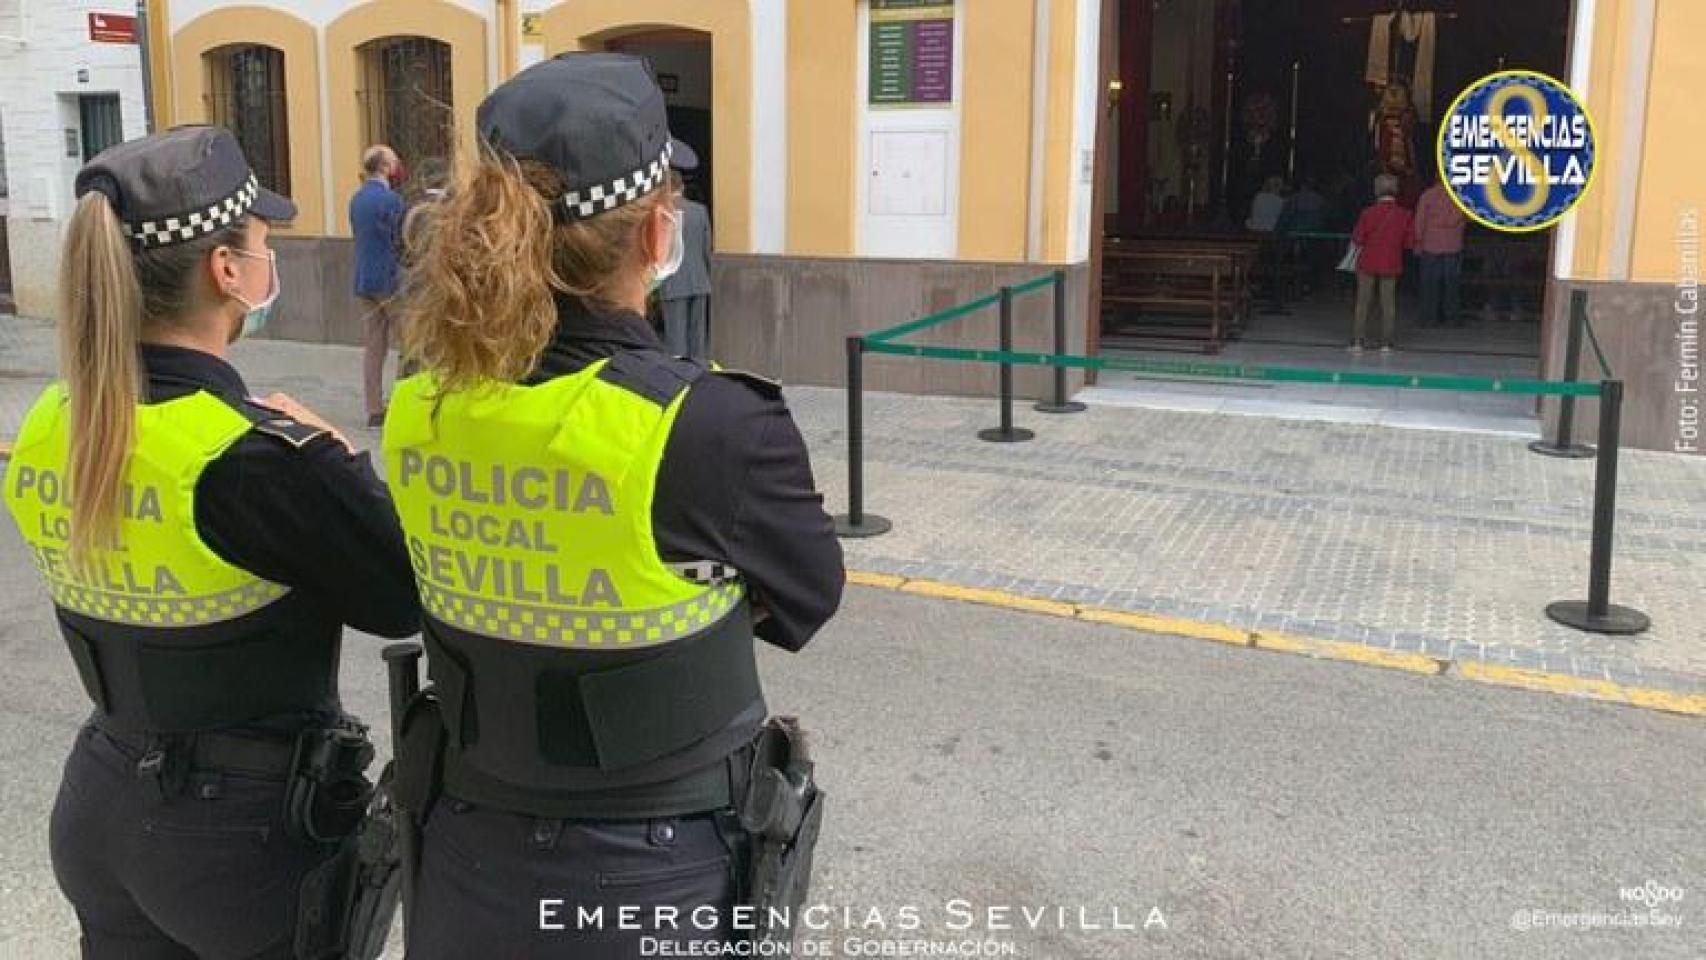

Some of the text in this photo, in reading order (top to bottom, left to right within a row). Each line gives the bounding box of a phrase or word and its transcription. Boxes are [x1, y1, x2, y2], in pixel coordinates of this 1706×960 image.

[400, 448, 614, 515] POLICIA
[430, 506, 558, 553] LOCAL
[411, 535, 622, 607] SEVILLA
